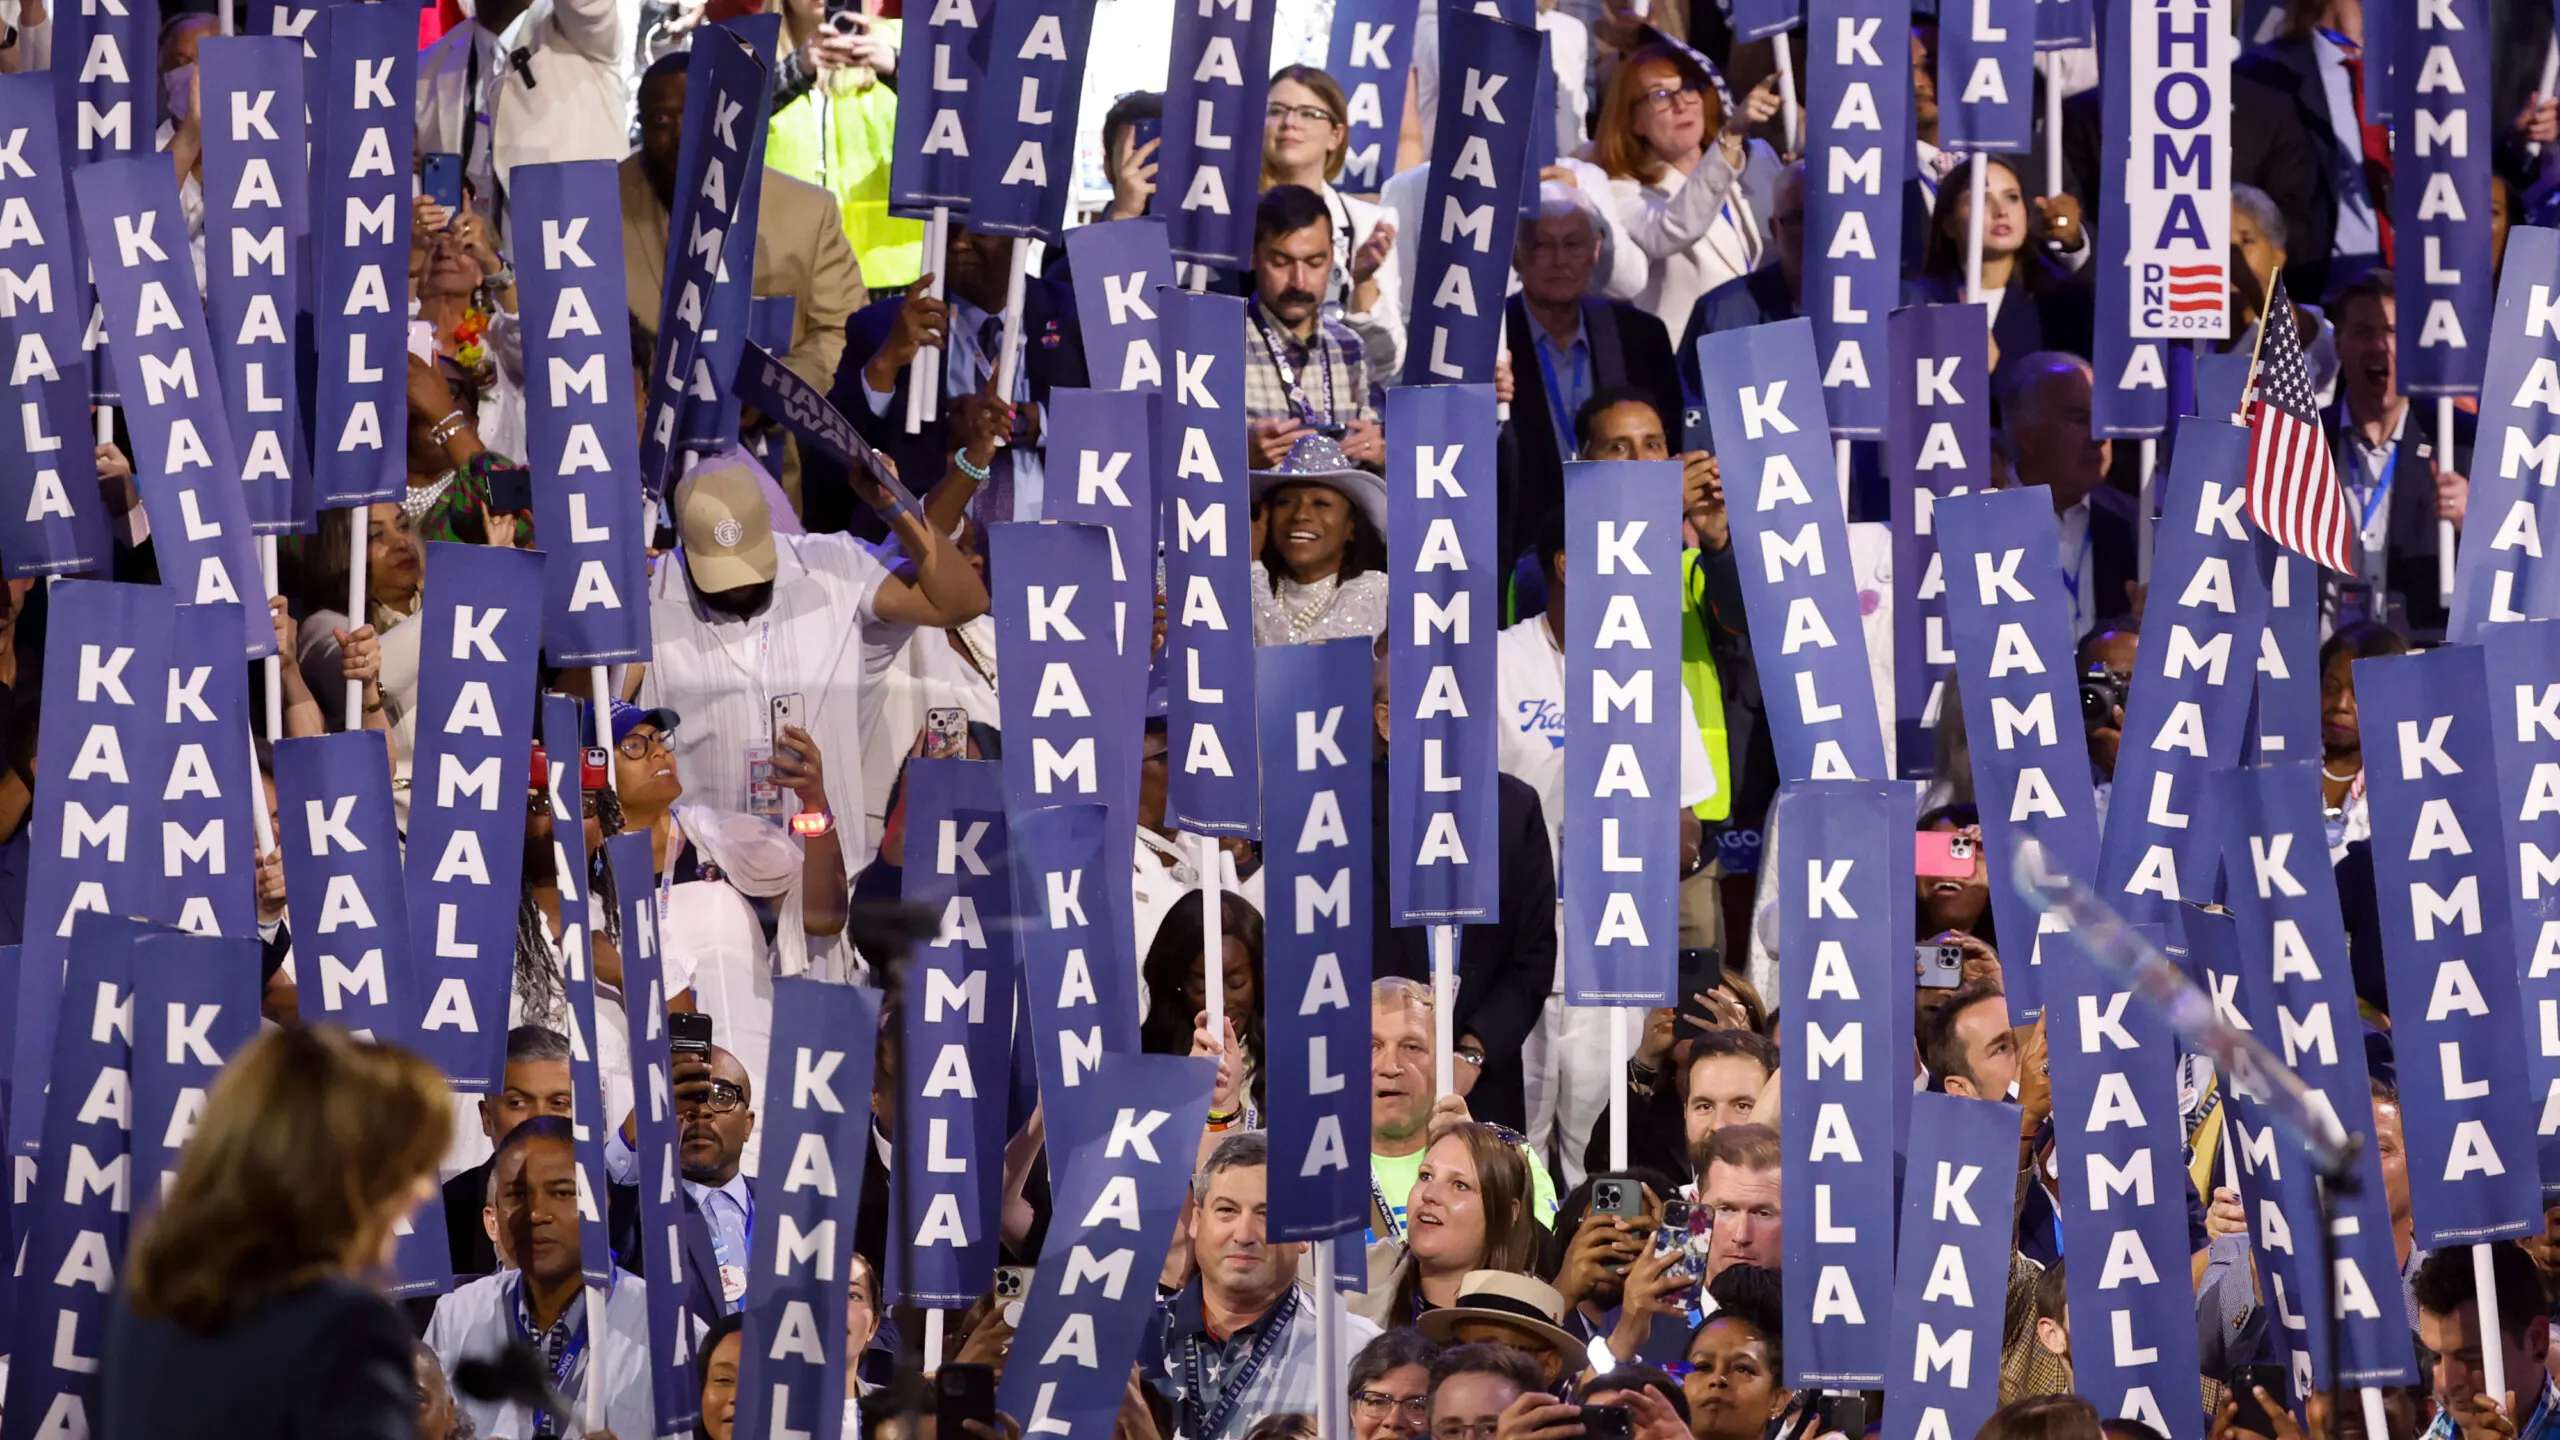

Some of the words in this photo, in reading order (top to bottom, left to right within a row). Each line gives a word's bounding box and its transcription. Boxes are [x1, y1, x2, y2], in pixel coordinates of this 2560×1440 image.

[921, 0, 979, 156] ALA
[1001, 14, 1067, 187] ALA
[1181, 0, 1250, 215] ALA
[1336, 22, 1394, 189] KAM
[1430, 67, 1508, 380] KAMAL
[1823, 17, 1883, 388] KAMALA
[2153, 0, 2212, 249] HOMA
[114, 211, 241, 604] KAMALA
[231, 90, 290, 480] KAMALA
[337, 56, 396, 452] KAMALA
[542, 217, 622, 612] KAMALA
[653, 88, 743, 453] KAMALA
[2143, 263, 2164, 329] DNC
[2169, 314, 2223, 330] 2024
[1176, 350, 1234, 777] KAMALA
[1738, 380, 1857, 780] KAMALA
[2488, 285, 2560, 622] KAMAL
[57, 644, 135, 937] KAMA
[162, 666, 226, 937] KAMA
[421, 604, 508, 1033] KAMALA
[1026, 584, 1097, 794] KAM
[1413, 444, 1470, 865] KAMALA
[1593, 520, 1653, 946] KAMALA
[2125, 481, 2250, 900] KAMALA
[305, 795, 389, 1044] KAM
[914, 820, 991, 1247] KAMALA
[1046, 868, 1103, 1088] KAM
[1295, 705, 1350, 1177] KAMALA
[1806, 859, 1865, 1324] KAMALA
[2397, 714, 2505, 1181] KAMALA
[770, 1047, 845, 1440] KAMAL
[1026, 1108, 1171, 1437] KAMAL
[1247, 1109, 1256, 1131] DNC
[2078, 992, 2171, 1440] KAMALA
[2495, 1222, 2527, 1232] PRESIDENT
[557, 1353, 574, 1377] DNC
